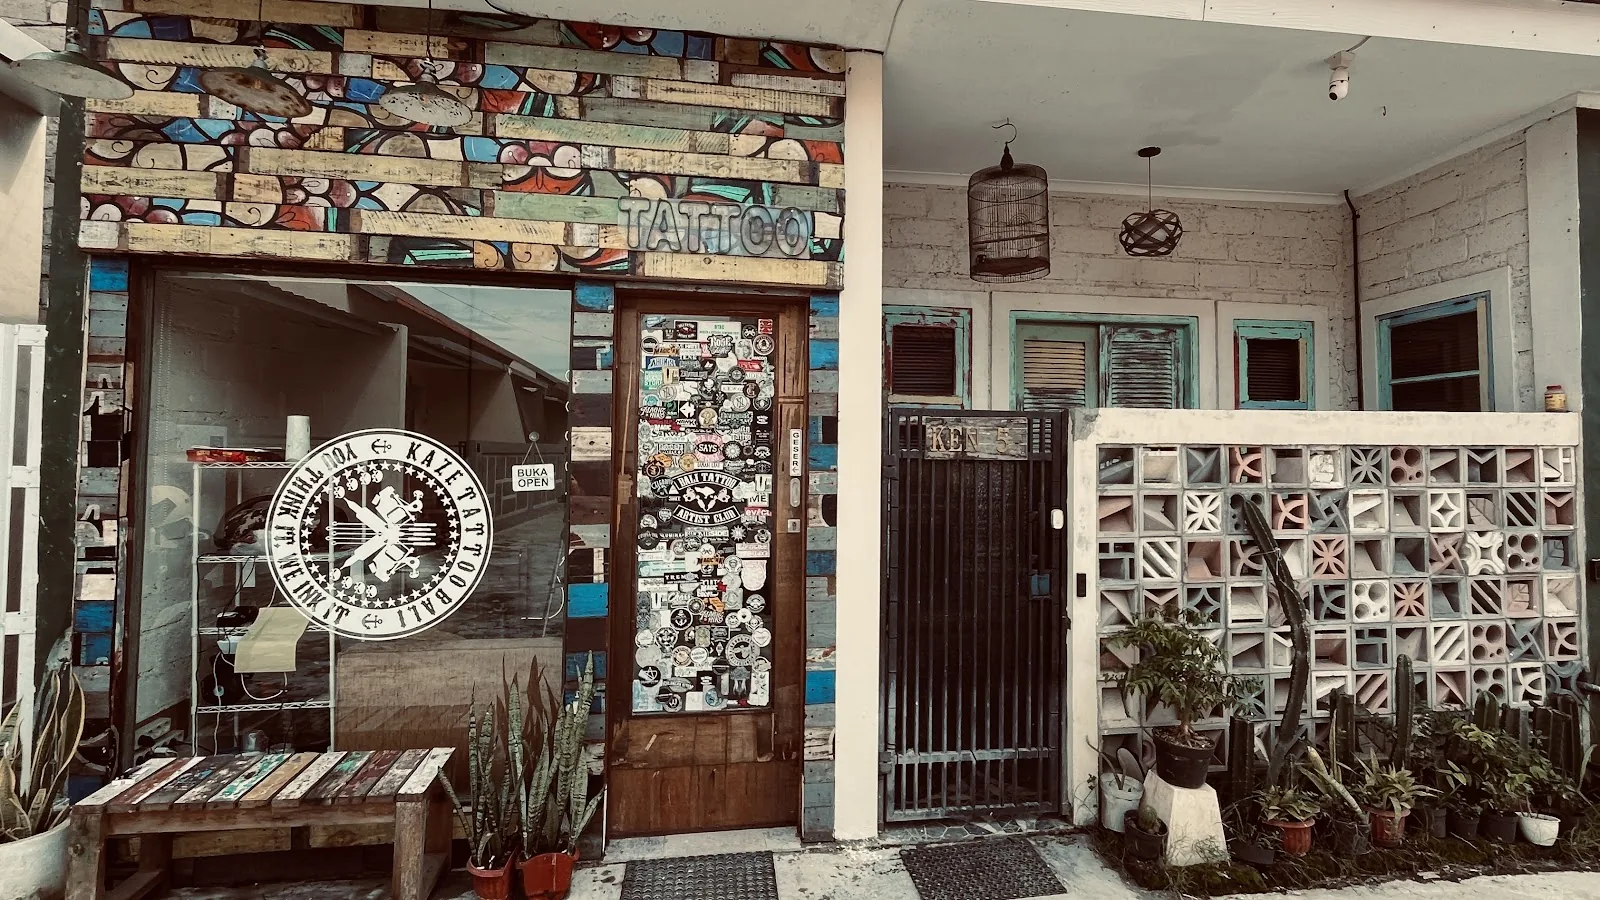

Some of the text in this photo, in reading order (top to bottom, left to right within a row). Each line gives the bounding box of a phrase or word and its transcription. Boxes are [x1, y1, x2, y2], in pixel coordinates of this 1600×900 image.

[618, 196, 809, 256] TATTOO
[698, 444, 718, 453] SAYS
[792, 432, 800, 467] GESER
[930, 424, 1010, 453] KEN 5
[321, 442, 358, 471] YOU
[517, 468, 548, 477] BUKA
[518, 478, 549, 487] OPEN
[677, 473, 699, 488] BALI
[700, 472, 738, 489] TATTOO
[277, 467, 324, 520] THINK
[676, 509, 710, 524] ARTIST
[713, 509, 737, 523] CLUB
[399, 441, 485, 628] KAZE TATTOO BALI
[277, 553, 305, 582] WE
[292, 580, 327, 612] INK
[323, 603, 351, 625] IT
